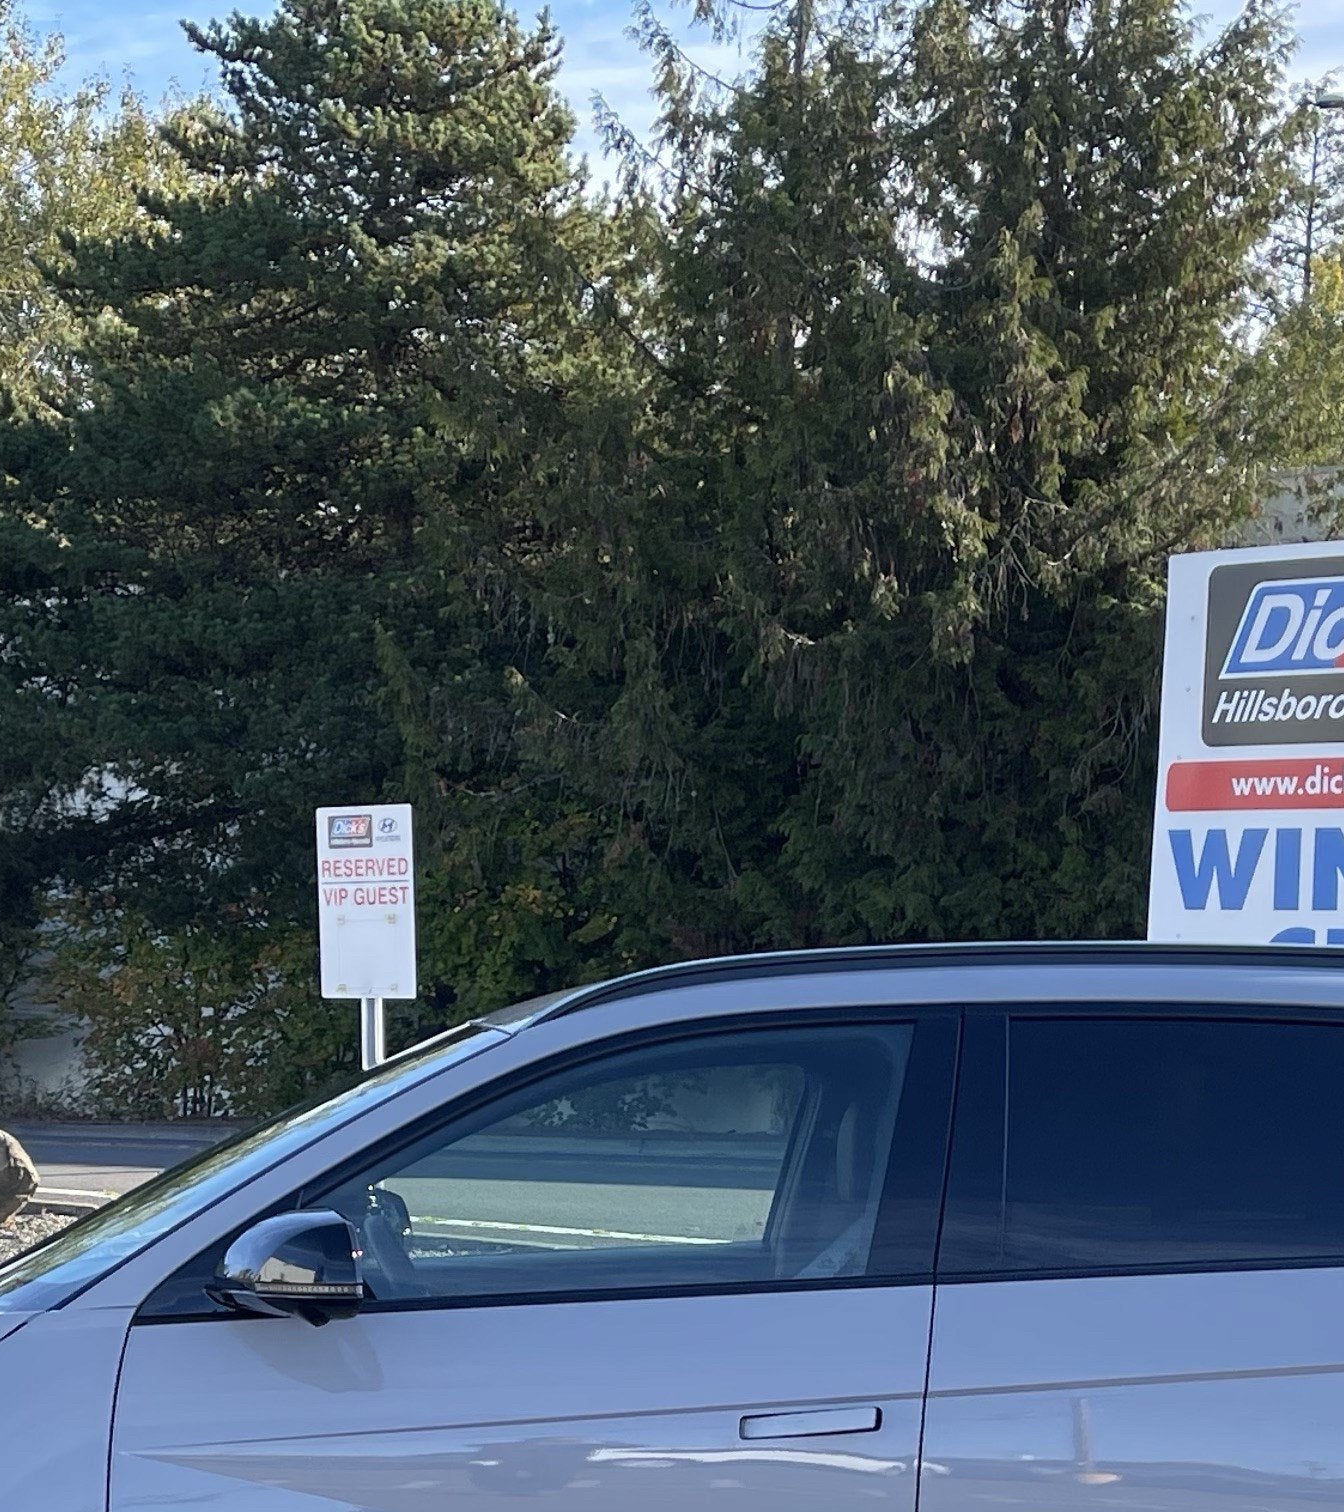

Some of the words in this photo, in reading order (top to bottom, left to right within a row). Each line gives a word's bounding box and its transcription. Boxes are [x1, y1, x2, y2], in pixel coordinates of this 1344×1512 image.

[321, 857, 409, 878] RESERVED
[323, 887, 349, 906] VIP
[353, 886, 409, 906] GUEST
